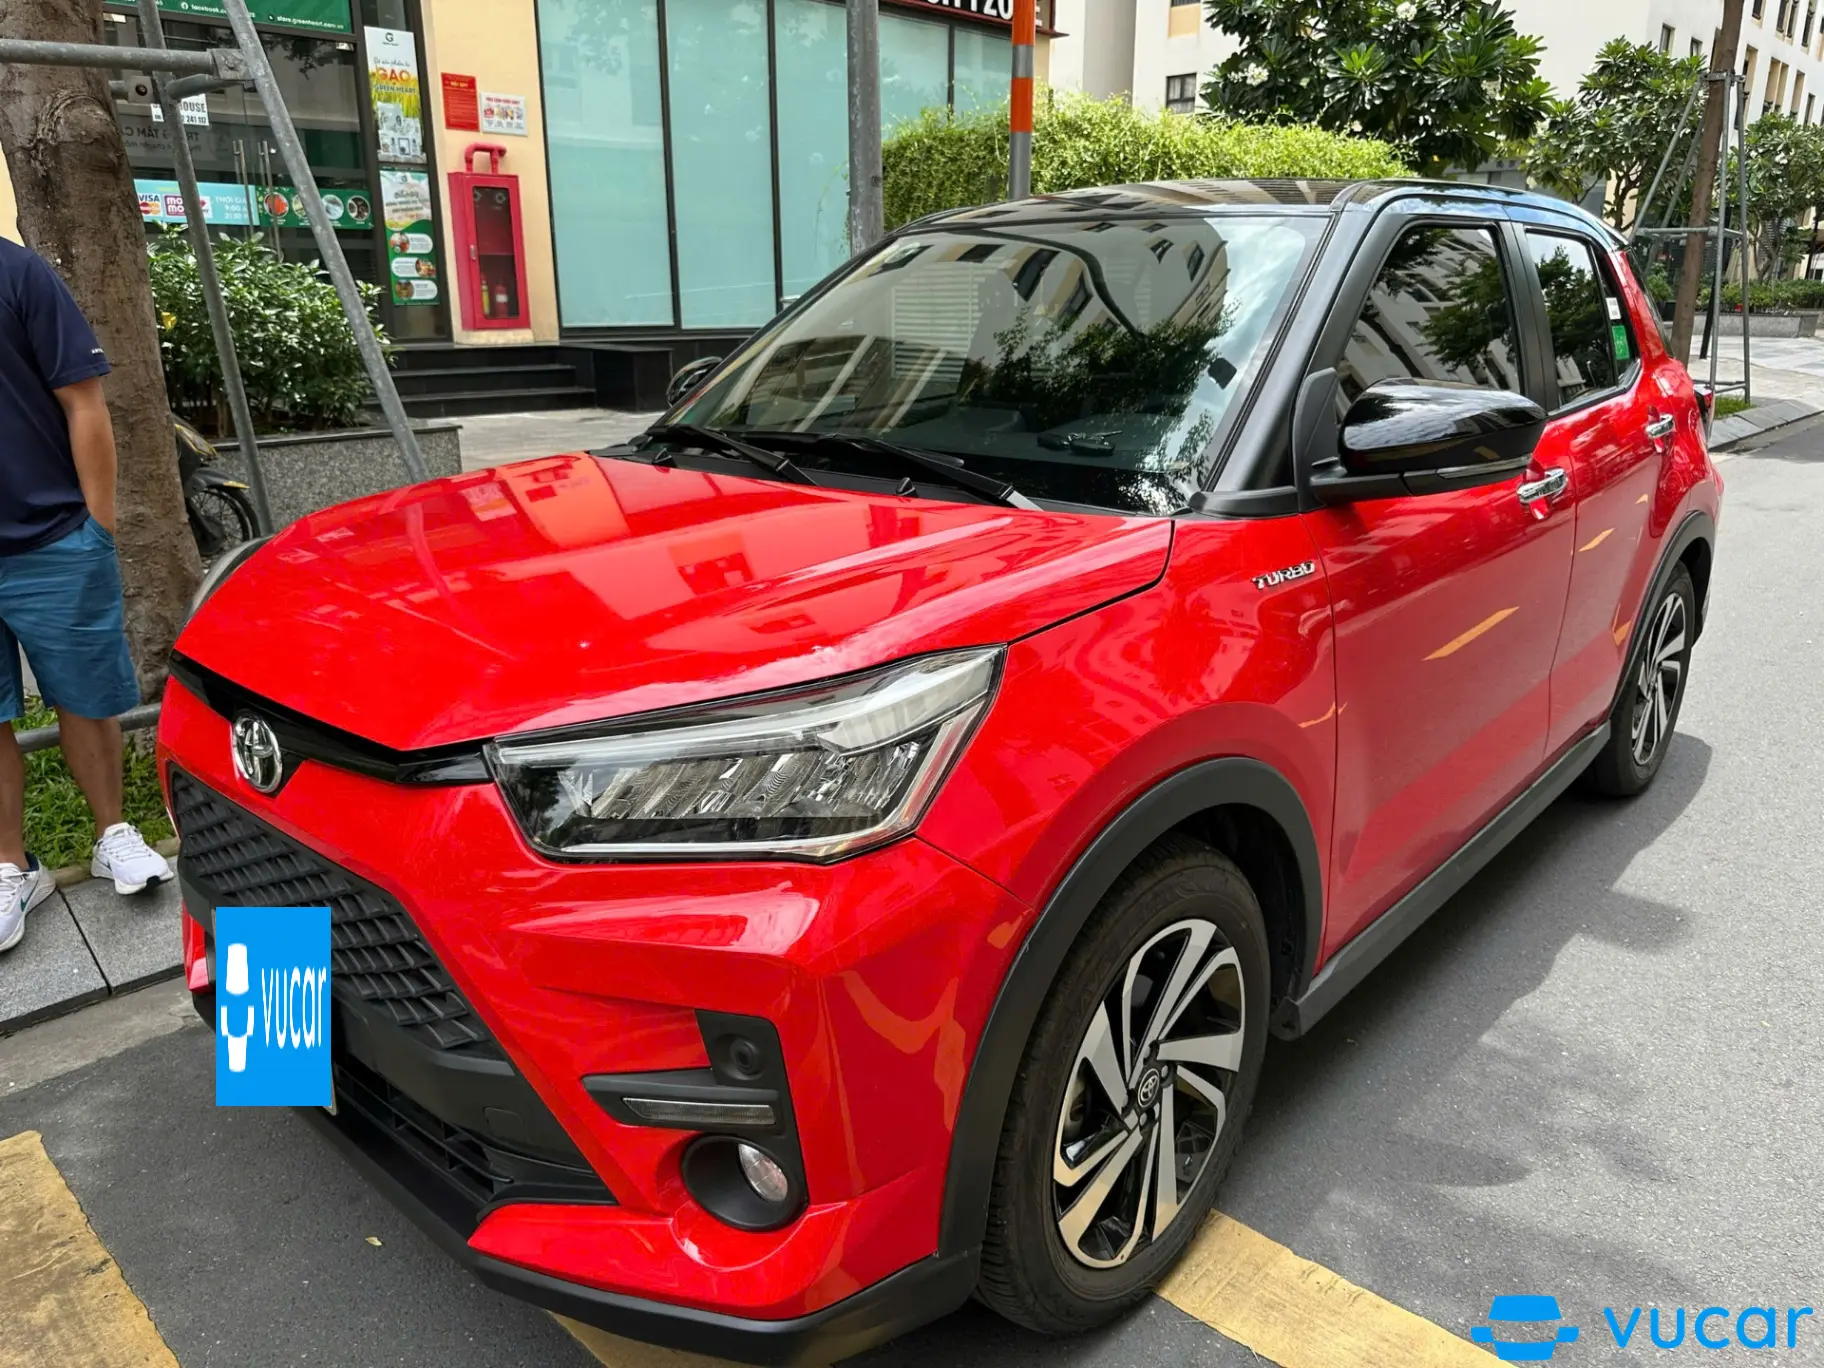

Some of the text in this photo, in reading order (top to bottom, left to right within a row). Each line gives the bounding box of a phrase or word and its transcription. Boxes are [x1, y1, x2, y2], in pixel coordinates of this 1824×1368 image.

[376, 67, 410, 85] GẠO
[180, 101, 206, 113] OUSE
[1251, 560, 1315, 590] TURBO
